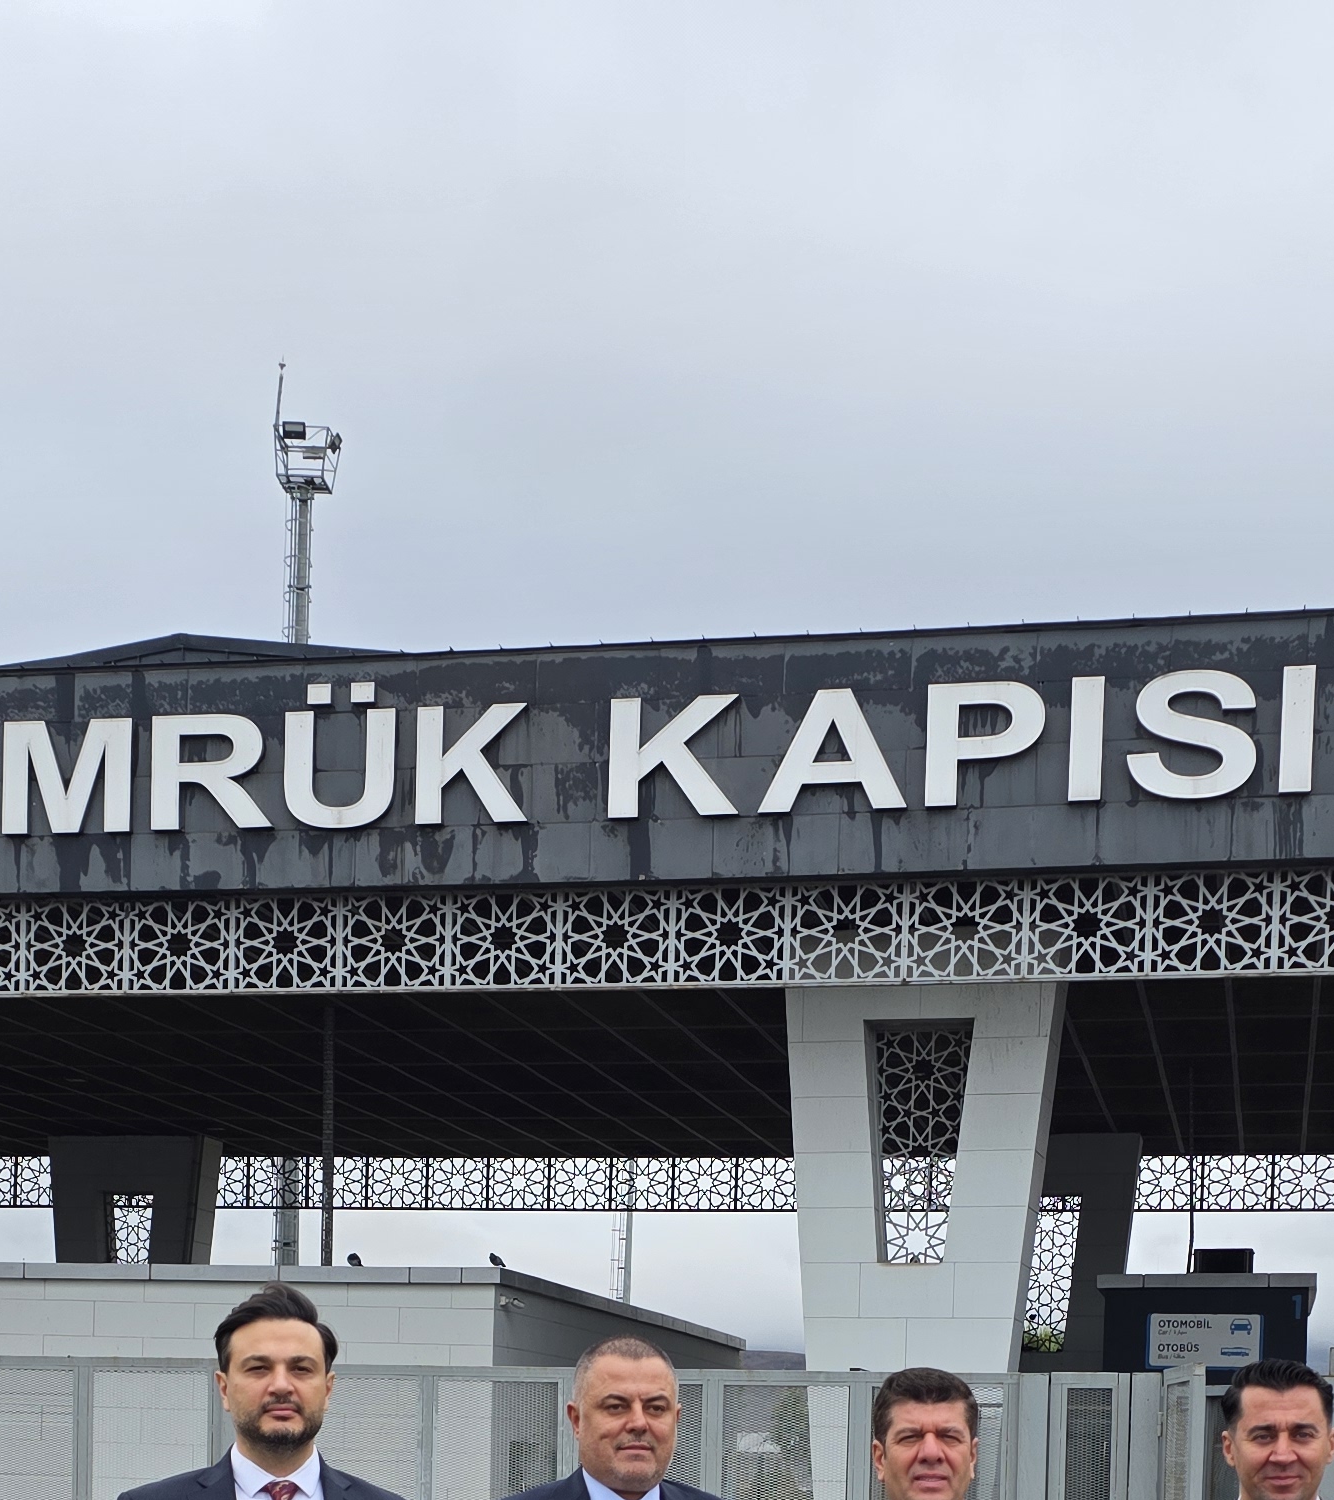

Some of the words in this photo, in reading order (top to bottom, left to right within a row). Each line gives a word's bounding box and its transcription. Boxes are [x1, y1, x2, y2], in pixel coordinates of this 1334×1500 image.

[608, 664, 1317, 819] KAPISI
[1292, 1294, 1302, 1319] 1
[1158, 1318, 1212, 1329] OTOMOBİL
[1157, 1342, 1200, 1352] OTOBÜS
